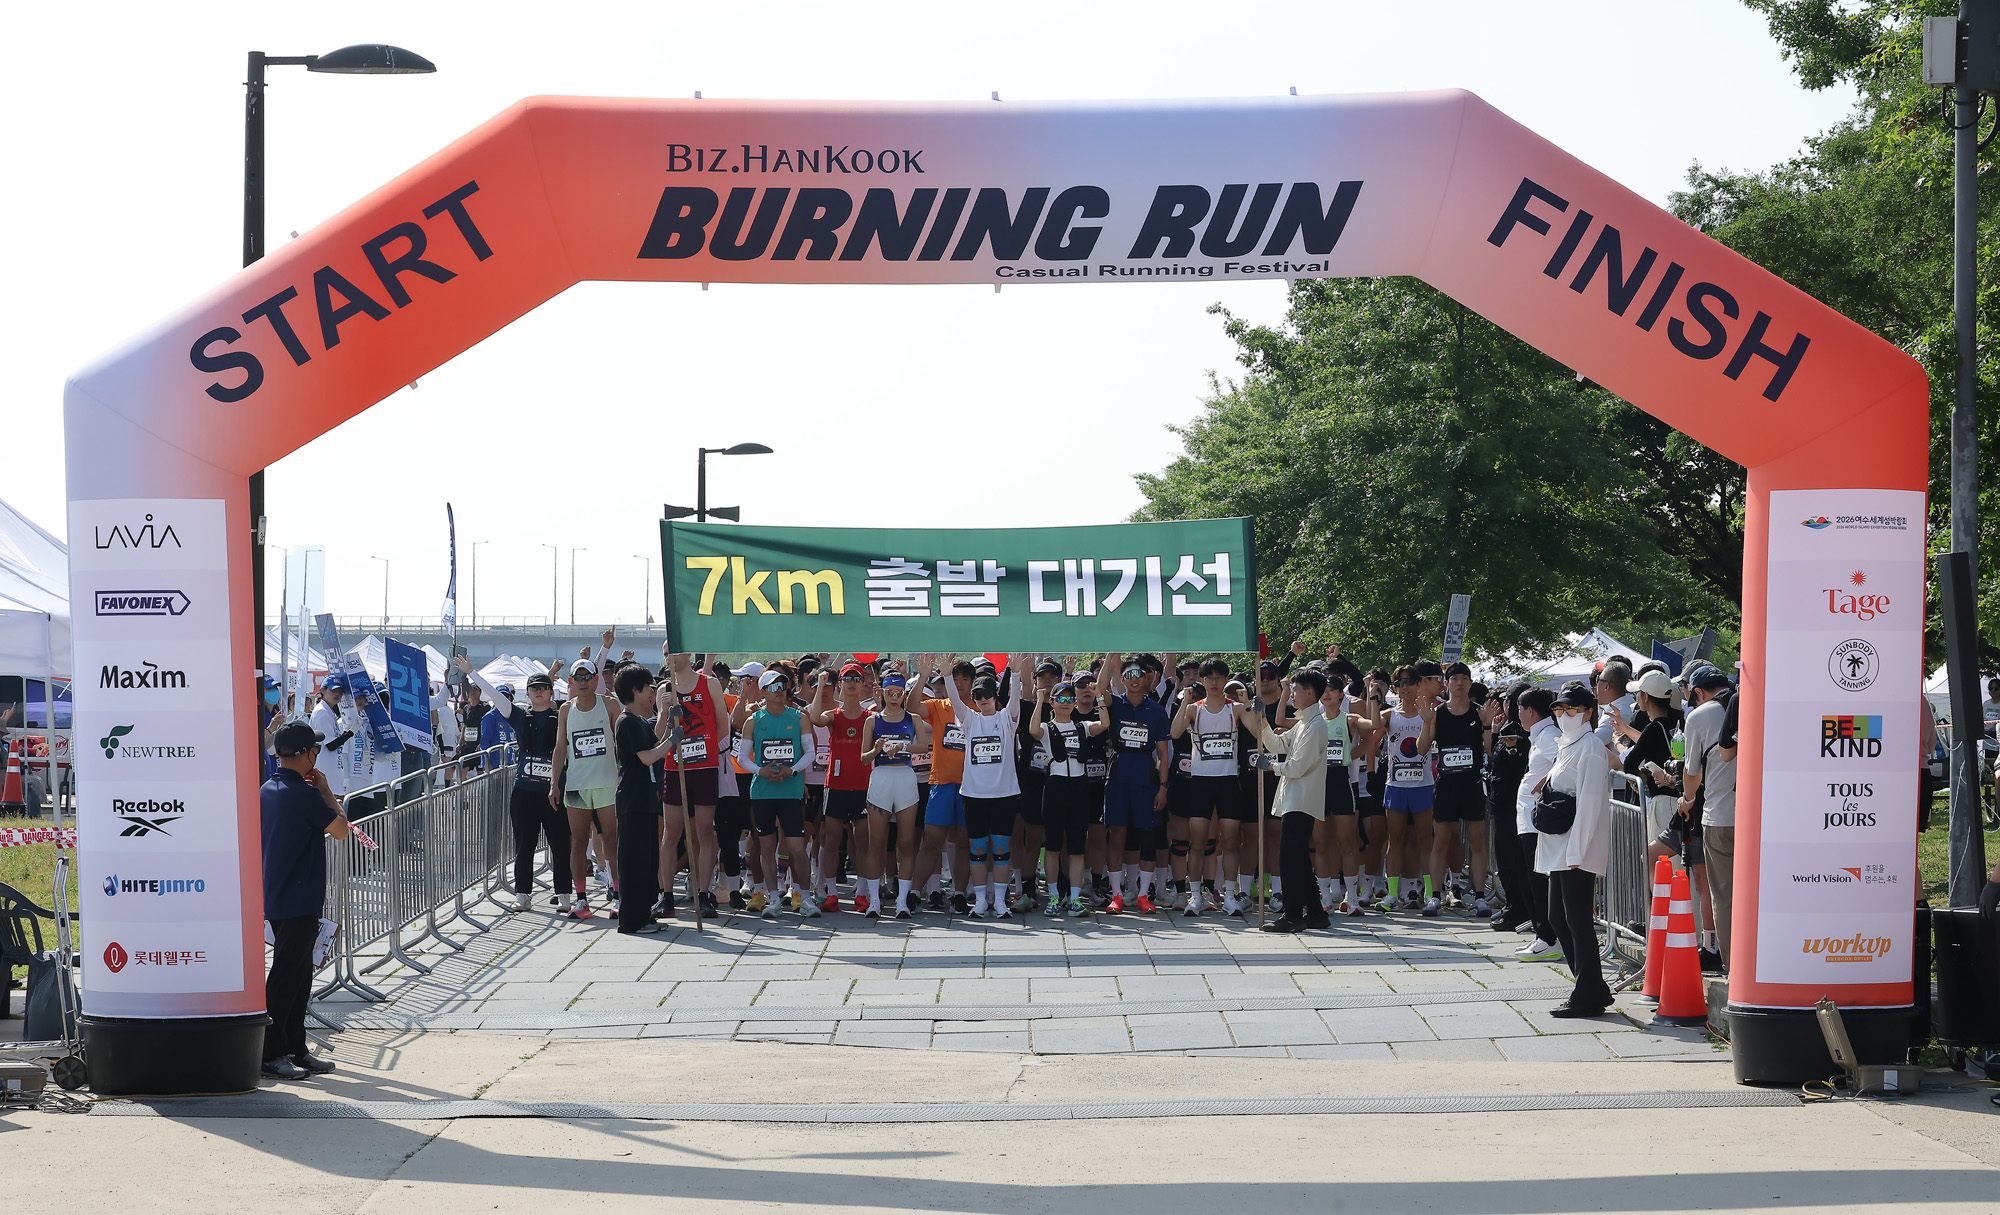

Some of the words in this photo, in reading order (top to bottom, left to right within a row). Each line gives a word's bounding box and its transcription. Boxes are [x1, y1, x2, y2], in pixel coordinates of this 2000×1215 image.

[637, 186, 1110, 262] BURNING
[1127, 181, 1364, 259] RUN
[995, 264, 1089, 278] Casual
[1099, 263, 1214, 278] Running
[1224, 260, 1331, 275] Festival
[189, 180, 494, 403] START
[1486, 177, 1811, 403] FINISH
[685, 555, 846, 617] 7km
[863, 556, 1007, 618] 출발
[1026, 552, 1234, 617] 대기선
[100, 596, 175, 610] FAVONEX
[1822, 588, 1891, 621] Tage
[1835, 641, 1875, 658] SUNBODY
[99, 660, 186, 689] Maxim
[390, 661, 422, 718] 감
[1838, 677, 1871, 689] TANNING
[1129, 729, 1148, 737] 7207
[584, 737, 604, 746] 7247
[686, 744, 705, 752] 7160
[1820, 738, 1882, 758] KIND
[121, 746, 196, 758] NEWTREE
[533, 765, 552, 773] 7797
[1827, 783, 1874, 798] TOUS
[112, 799, 186, 816] Reebok
[1842, 798, 1859, 812] les
[1823, 812, 1877, 830] JOURS
[21, 831, 53, 841] DANGER!
[1865, 864, 1885, 873] 후원을
[1792, 873, 1821, 883] World
[1823, 873, 1852, 883] Vision
[1886, 874, 1898, 884] 후원
[134, 950, 208, 966] 롯데웰푸드
